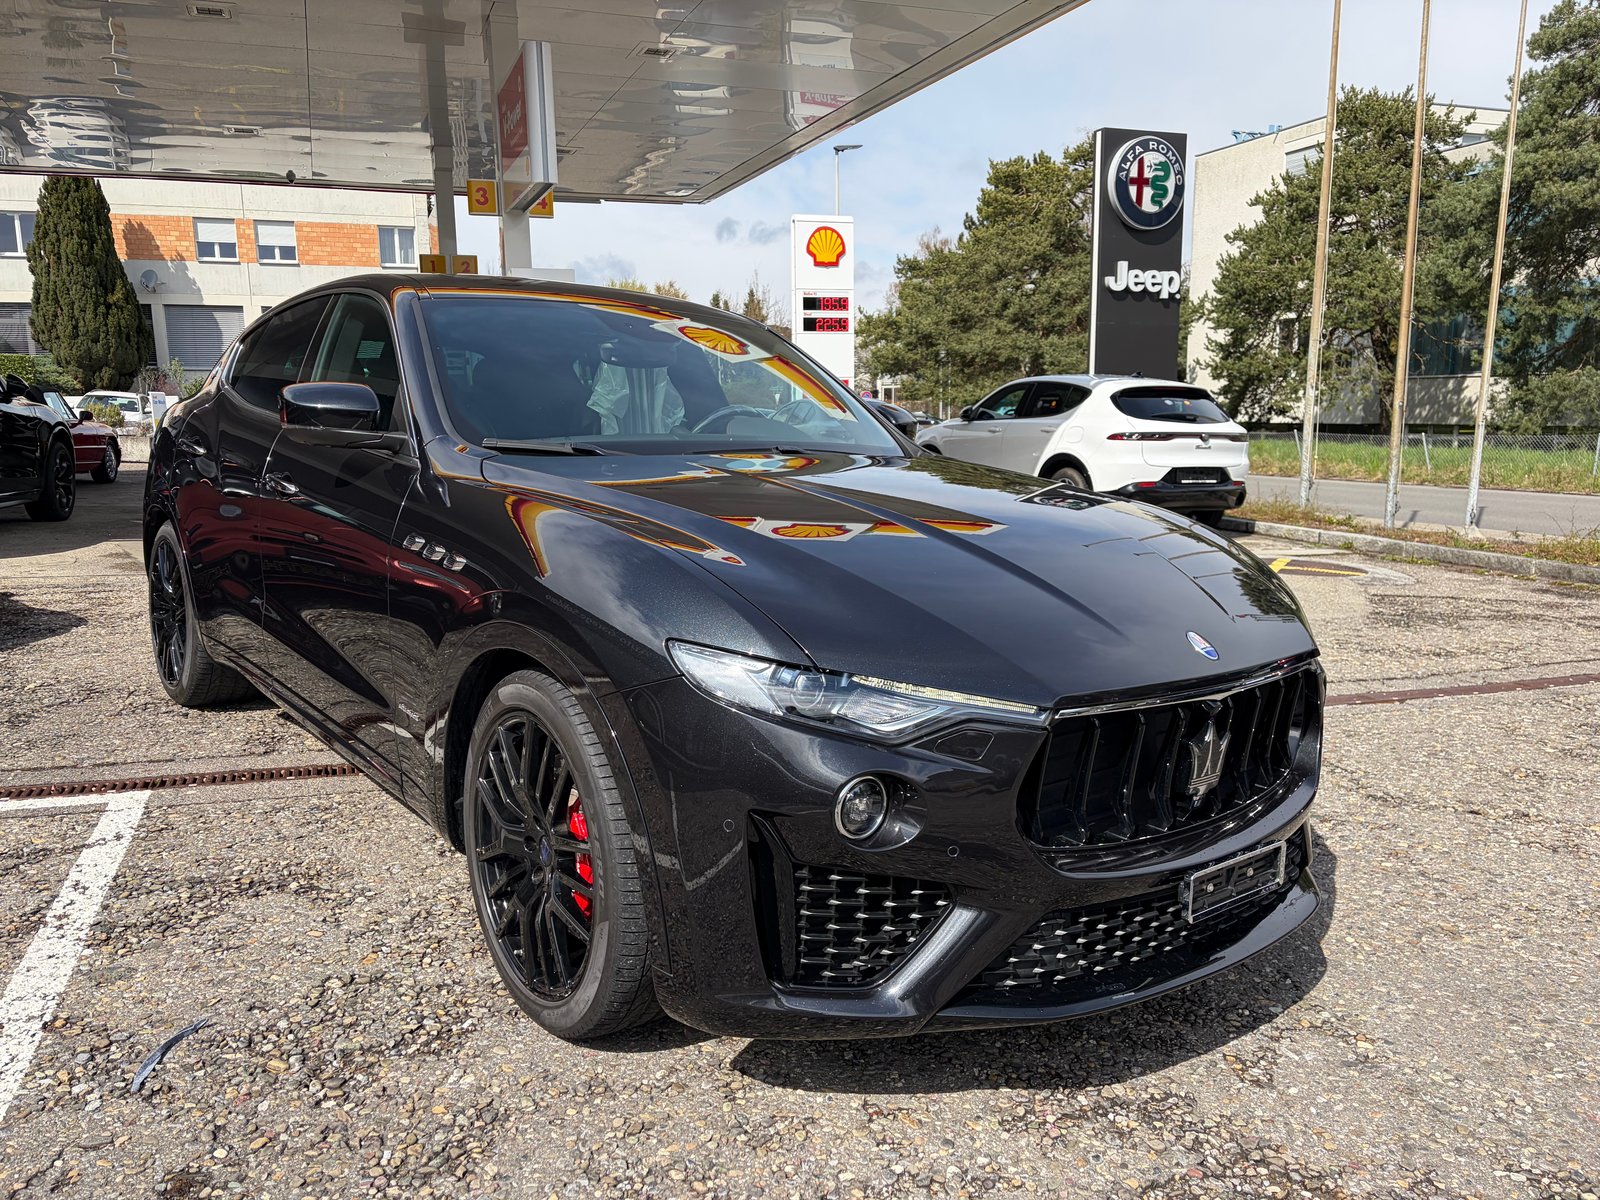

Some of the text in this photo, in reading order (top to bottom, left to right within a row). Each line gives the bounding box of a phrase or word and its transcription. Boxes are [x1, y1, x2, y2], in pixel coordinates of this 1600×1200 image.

[1118, 141, 1183, 186] ALFA ROMEO
[475, 187, 489, 206] 3
[430, 260, 436, 272] 1
[461, 261, 470, 273] 2
[1104, 260, 1181, 299] Jeep
